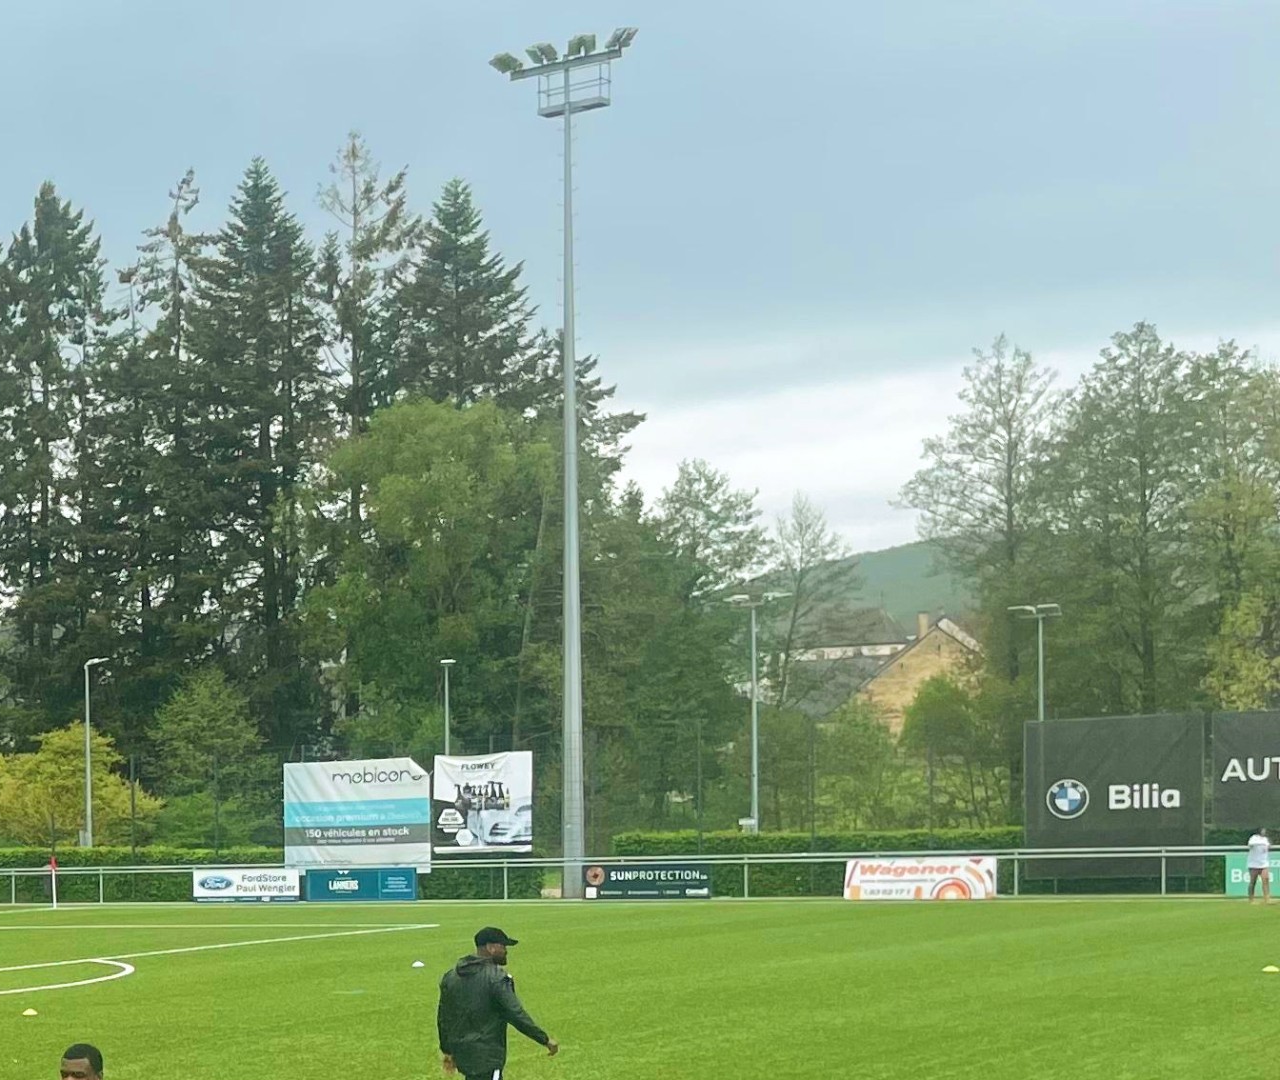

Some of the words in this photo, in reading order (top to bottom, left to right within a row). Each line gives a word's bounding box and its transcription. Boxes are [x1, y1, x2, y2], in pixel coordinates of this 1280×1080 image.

[461, 763, 495, 771] FLOWEY
[1108, 783, 1181, 810] Bilia
[305, 829, 322, 838] 150
[323, 827, 367, 838] véhicules
[368, 829, 381, 837] en
[383, 826, 410, 837] stock
[241, 874, 287, 883] FordStore
[610, 870, 700, 881] SUNPROTECTION
[236, 884, 257, 893] Paul
